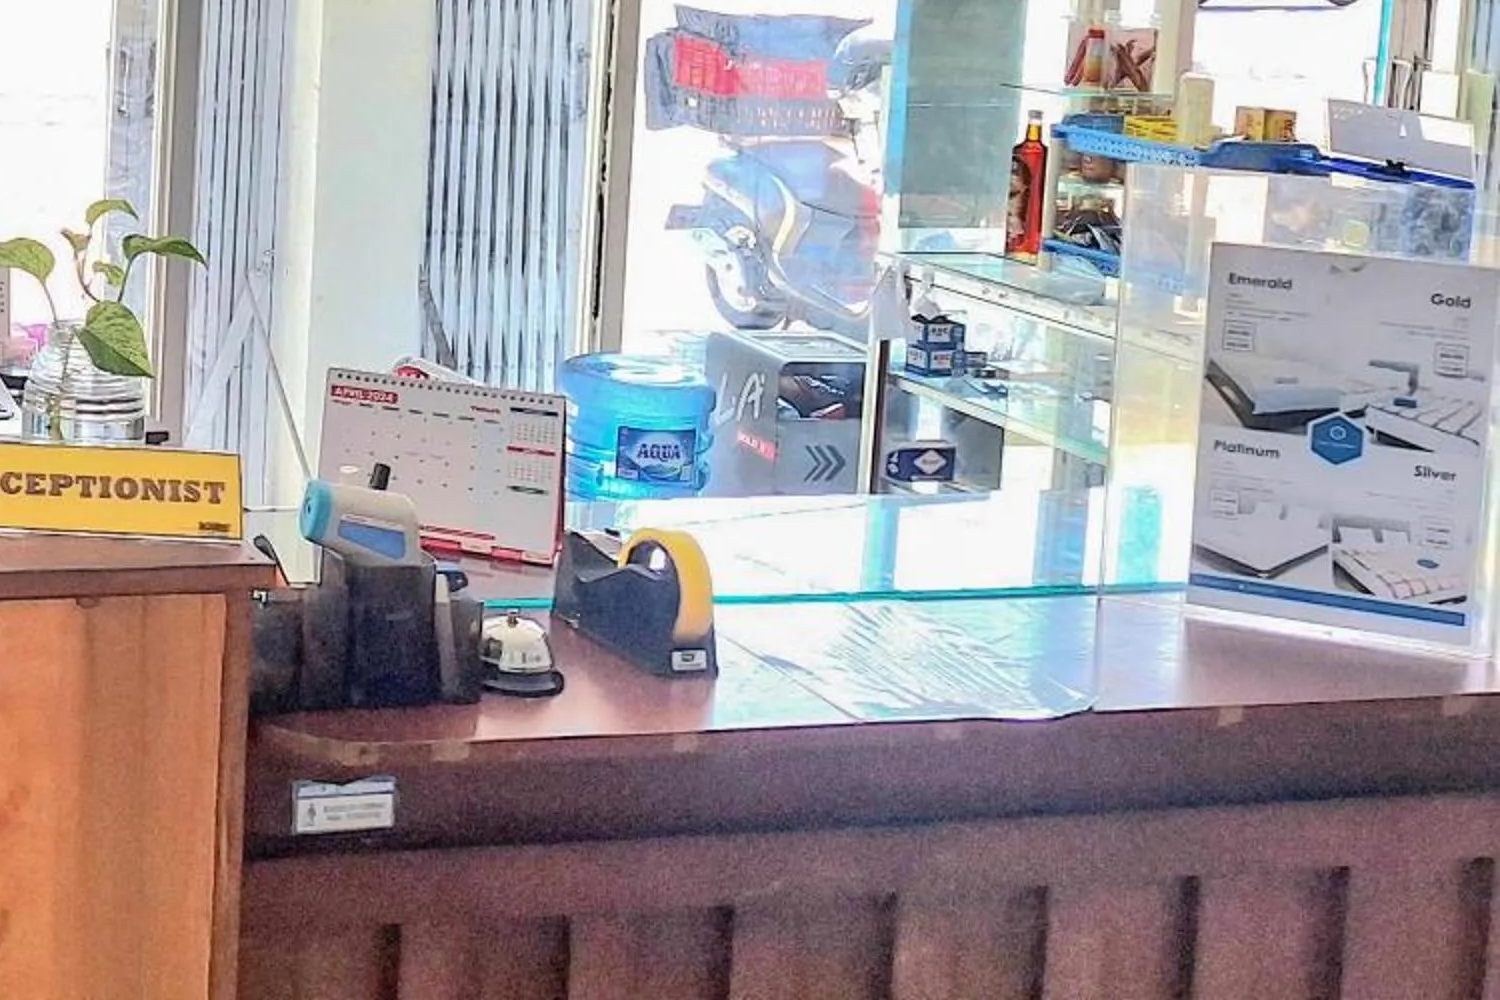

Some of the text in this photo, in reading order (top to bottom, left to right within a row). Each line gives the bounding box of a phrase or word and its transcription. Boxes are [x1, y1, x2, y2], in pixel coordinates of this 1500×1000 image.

[1228, 272, 1293, 290] Emerald
[1430, 293, 1471, 310] Gold
[637, 443, 681, 463] AQUA
[1213, 439, 1281, 459] Platinum
[1413, 465, 1457, 482] Silver
